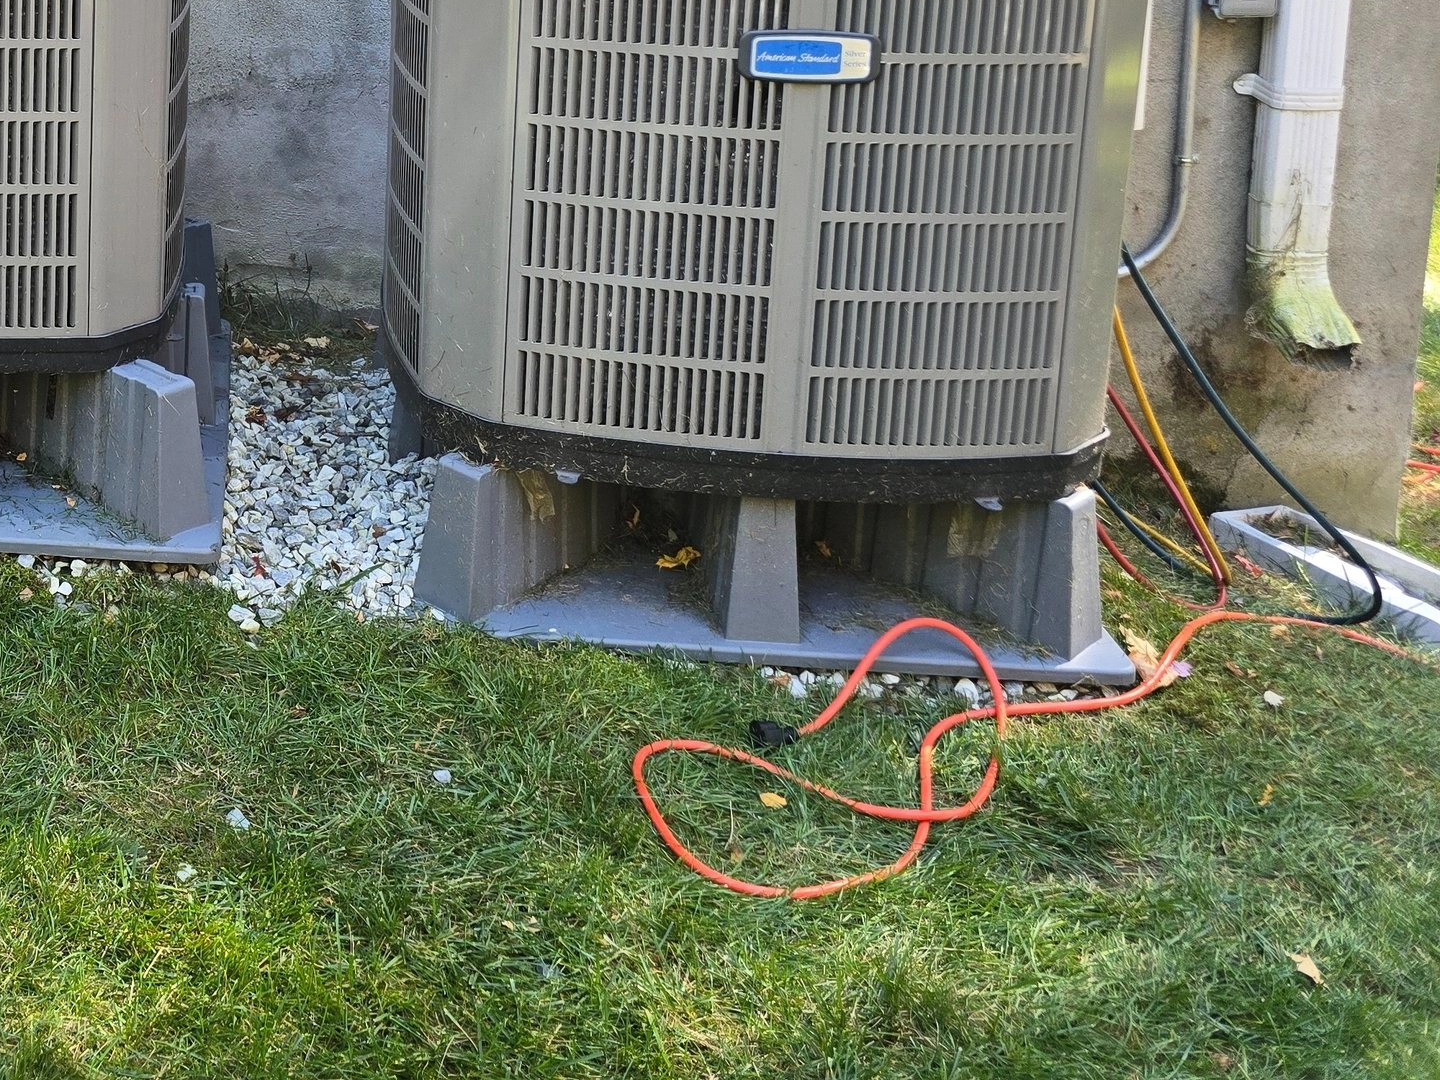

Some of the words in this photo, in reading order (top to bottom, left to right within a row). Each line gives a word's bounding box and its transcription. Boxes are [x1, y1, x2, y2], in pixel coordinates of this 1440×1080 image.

[756, 51, 797, 63] American
[798, 52, 841, 64] Standard
[845, 50, 866, 58] Silver
[843, 60, 867, 69] Series
